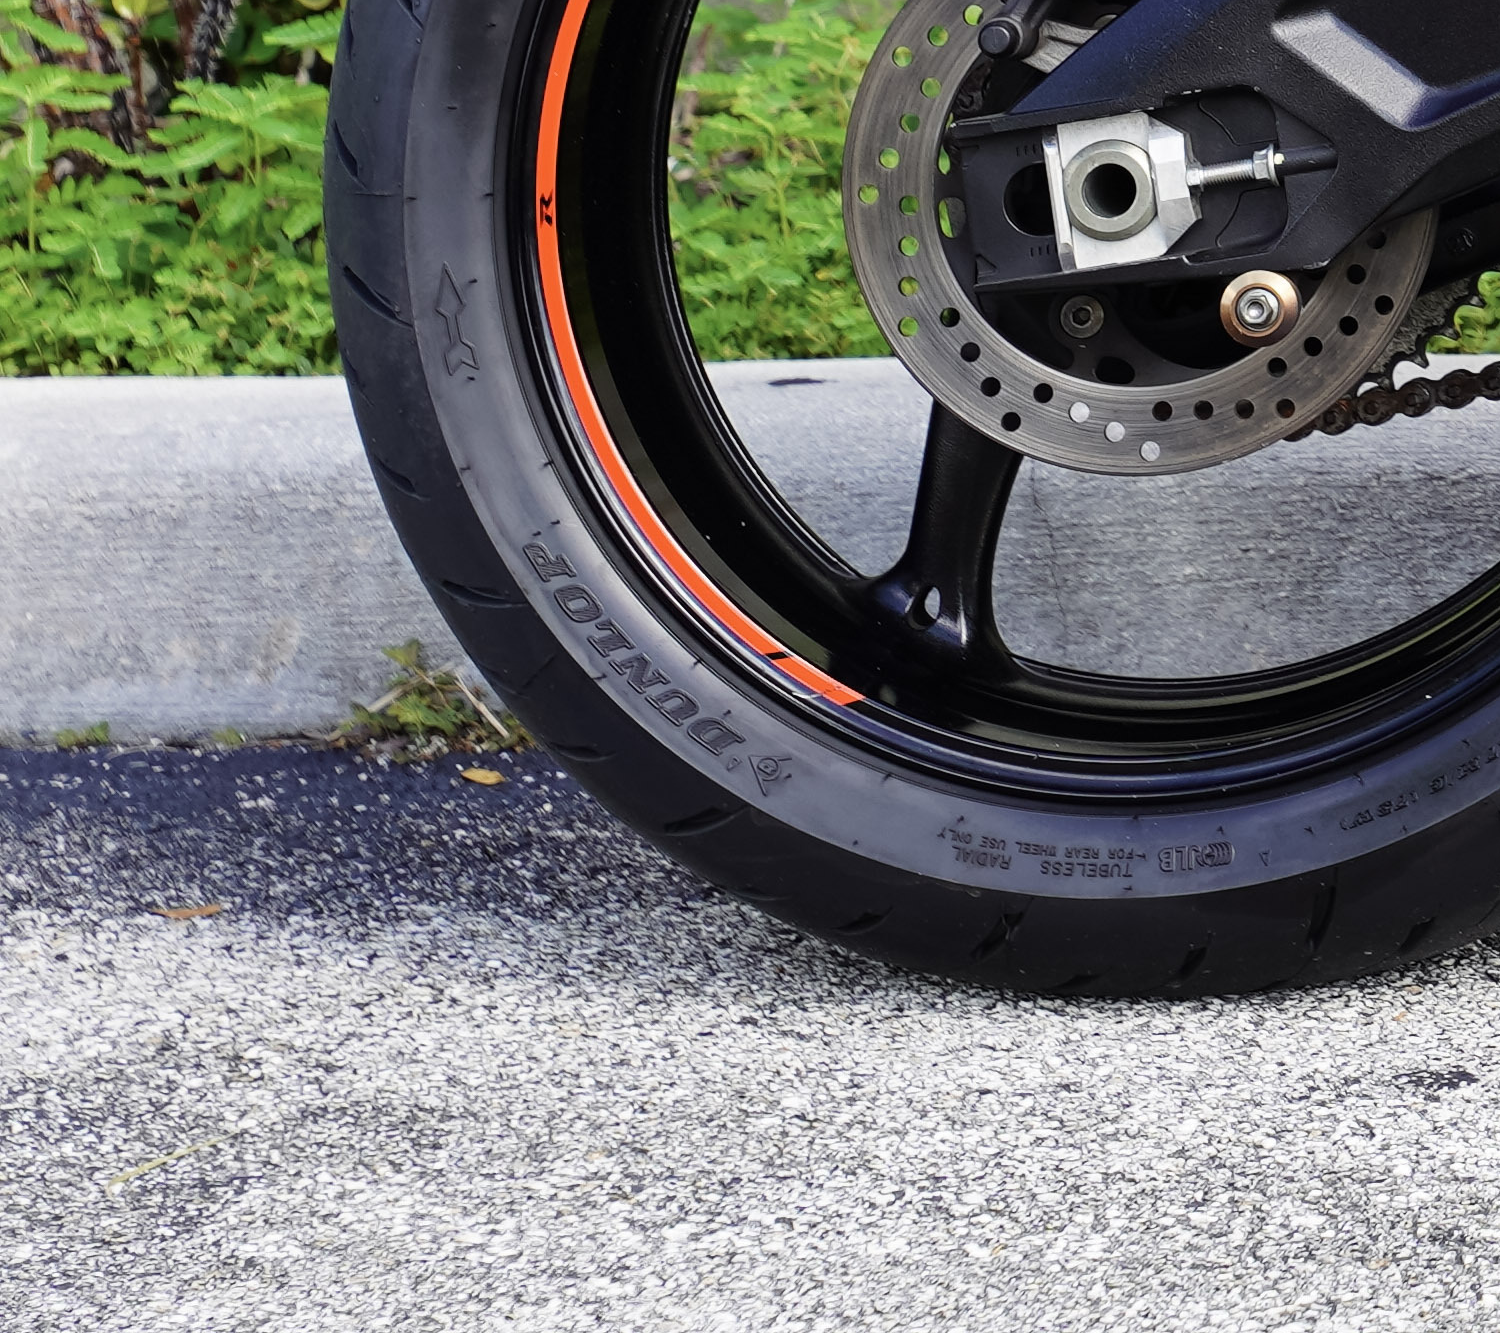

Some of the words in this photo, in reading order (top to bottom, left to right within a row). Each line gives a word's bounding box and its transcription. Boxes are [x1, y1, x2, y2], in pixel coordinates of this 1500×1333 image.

[519, 529, 746, 766] DUNLOP
[934, 825, 973, 846] ONLY
[978, 835, 1007, 852] USE
[947, 842, 1013, 871] RADIAL
[1012, 840, 1057, 857] WHEEL
[1063, 845, 1100, 858] REAR
[1106, 847, 1134, 859] FOR
[1037, 856, 1133, 880] TUBELESS
